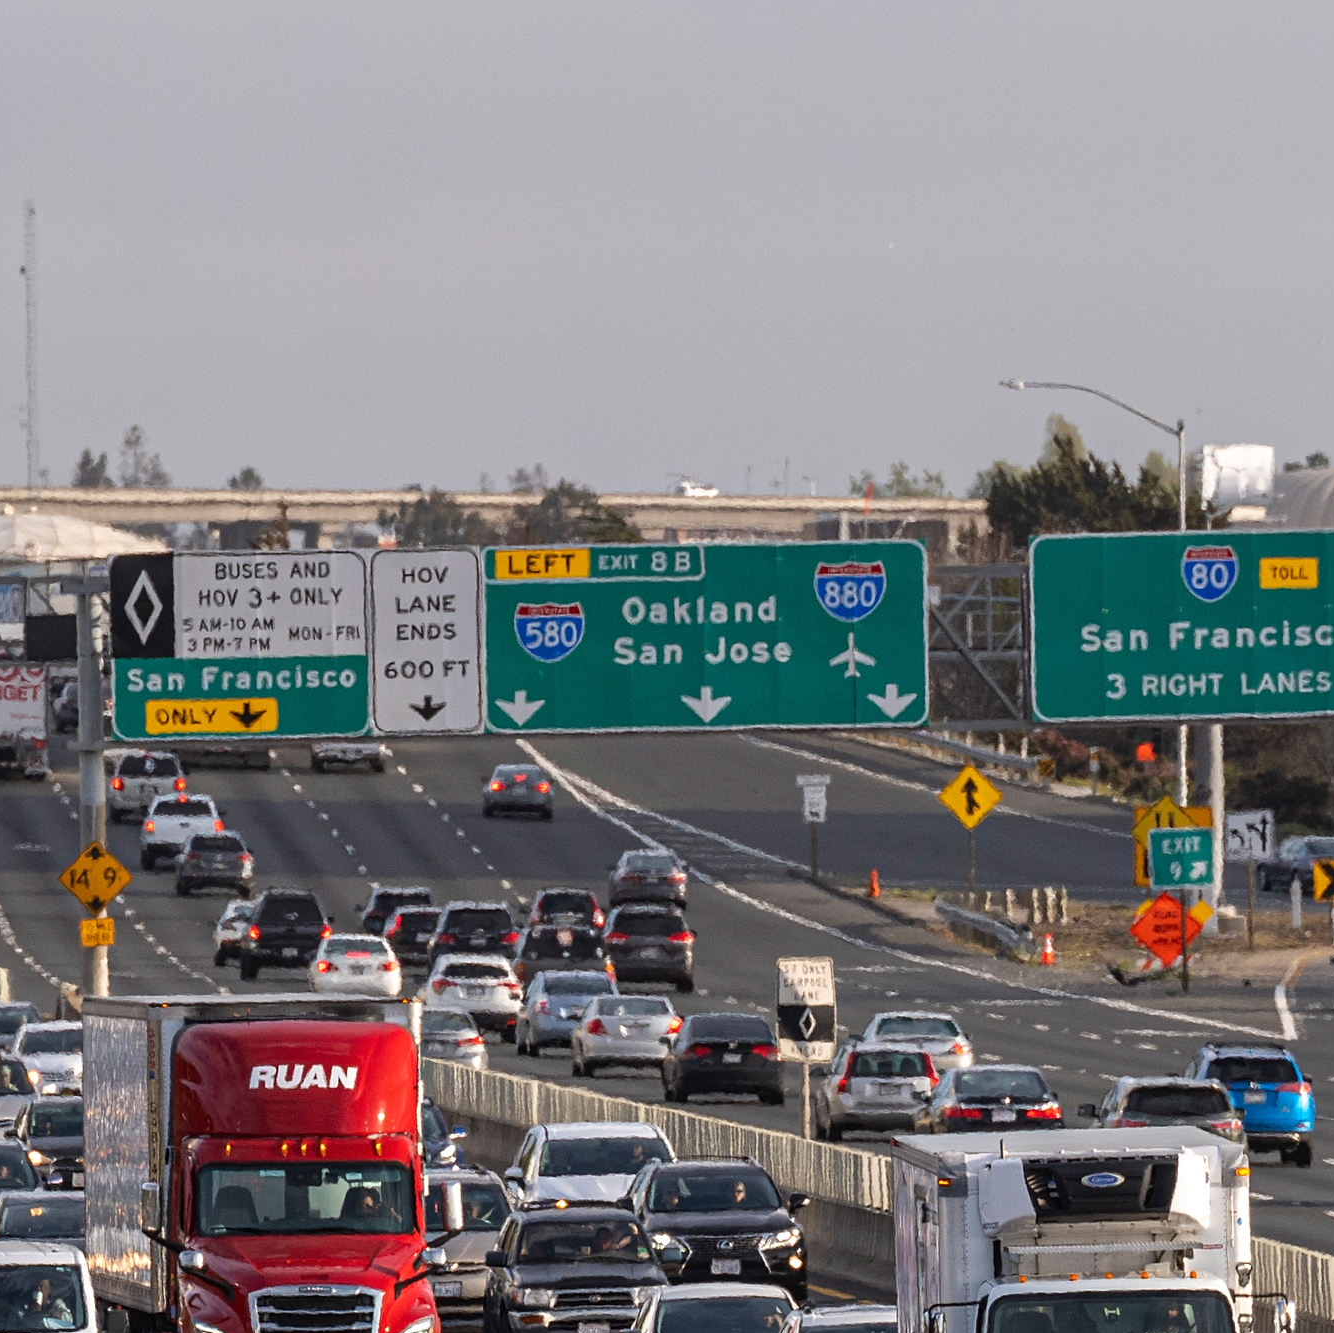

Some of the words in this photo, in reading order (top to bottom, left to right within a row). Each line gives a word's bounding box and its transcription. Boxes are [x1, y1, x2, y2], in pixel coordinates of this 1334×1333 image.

[215, 561, 278, 581] BUSES
[289, 561, 330, 579] AND
[508, 554, 575, 574] LEFT
[598, 553, 639, 570] EXIT
[1271, 566, 1308, 581] TOLL
[401, 567, 449, 584] HOV
[1191, 564, 1228, 589] 80
[198, 589, 239, 608] HOV
[289, 588, 343, 605] ONLY
[396, 595, 456, 613] LANE
[824, 582, 875, 607] 880
[622, 597, 777, 624] Oakland
[182, 618, 193, 631] 5
[251, 617, 275, 631] AM
[396, 624, 457, 641] ENDS
[187, 638, 198, 652] 3
[249, 637, 271, 651] PM
[525, 623, 578, 649] 580
[1080, 623, 1149, 652] San
[613, 637, 683, 665] San
[705, 637, 792, 664] Jose
[127, 667, 185, 692] San
[201, 665, 357, 692] Francisco
[384, 660, 434, 678] 600
[443, 659, 470, 678] FT
[1106, 674, 1126, 700] 3
[1142, 673, 1224, 697] RIGHT
[1240, 671, 1331, 695] LANES
[155, 707, 217, 725] ONLY
[1162, 836, 1201, 854] EXIT
[1170, 861, 1183, 881] 9
[249, 1064, 358, 1091] RUAN
[1091, 1174, 1116, 1186] Carrier
